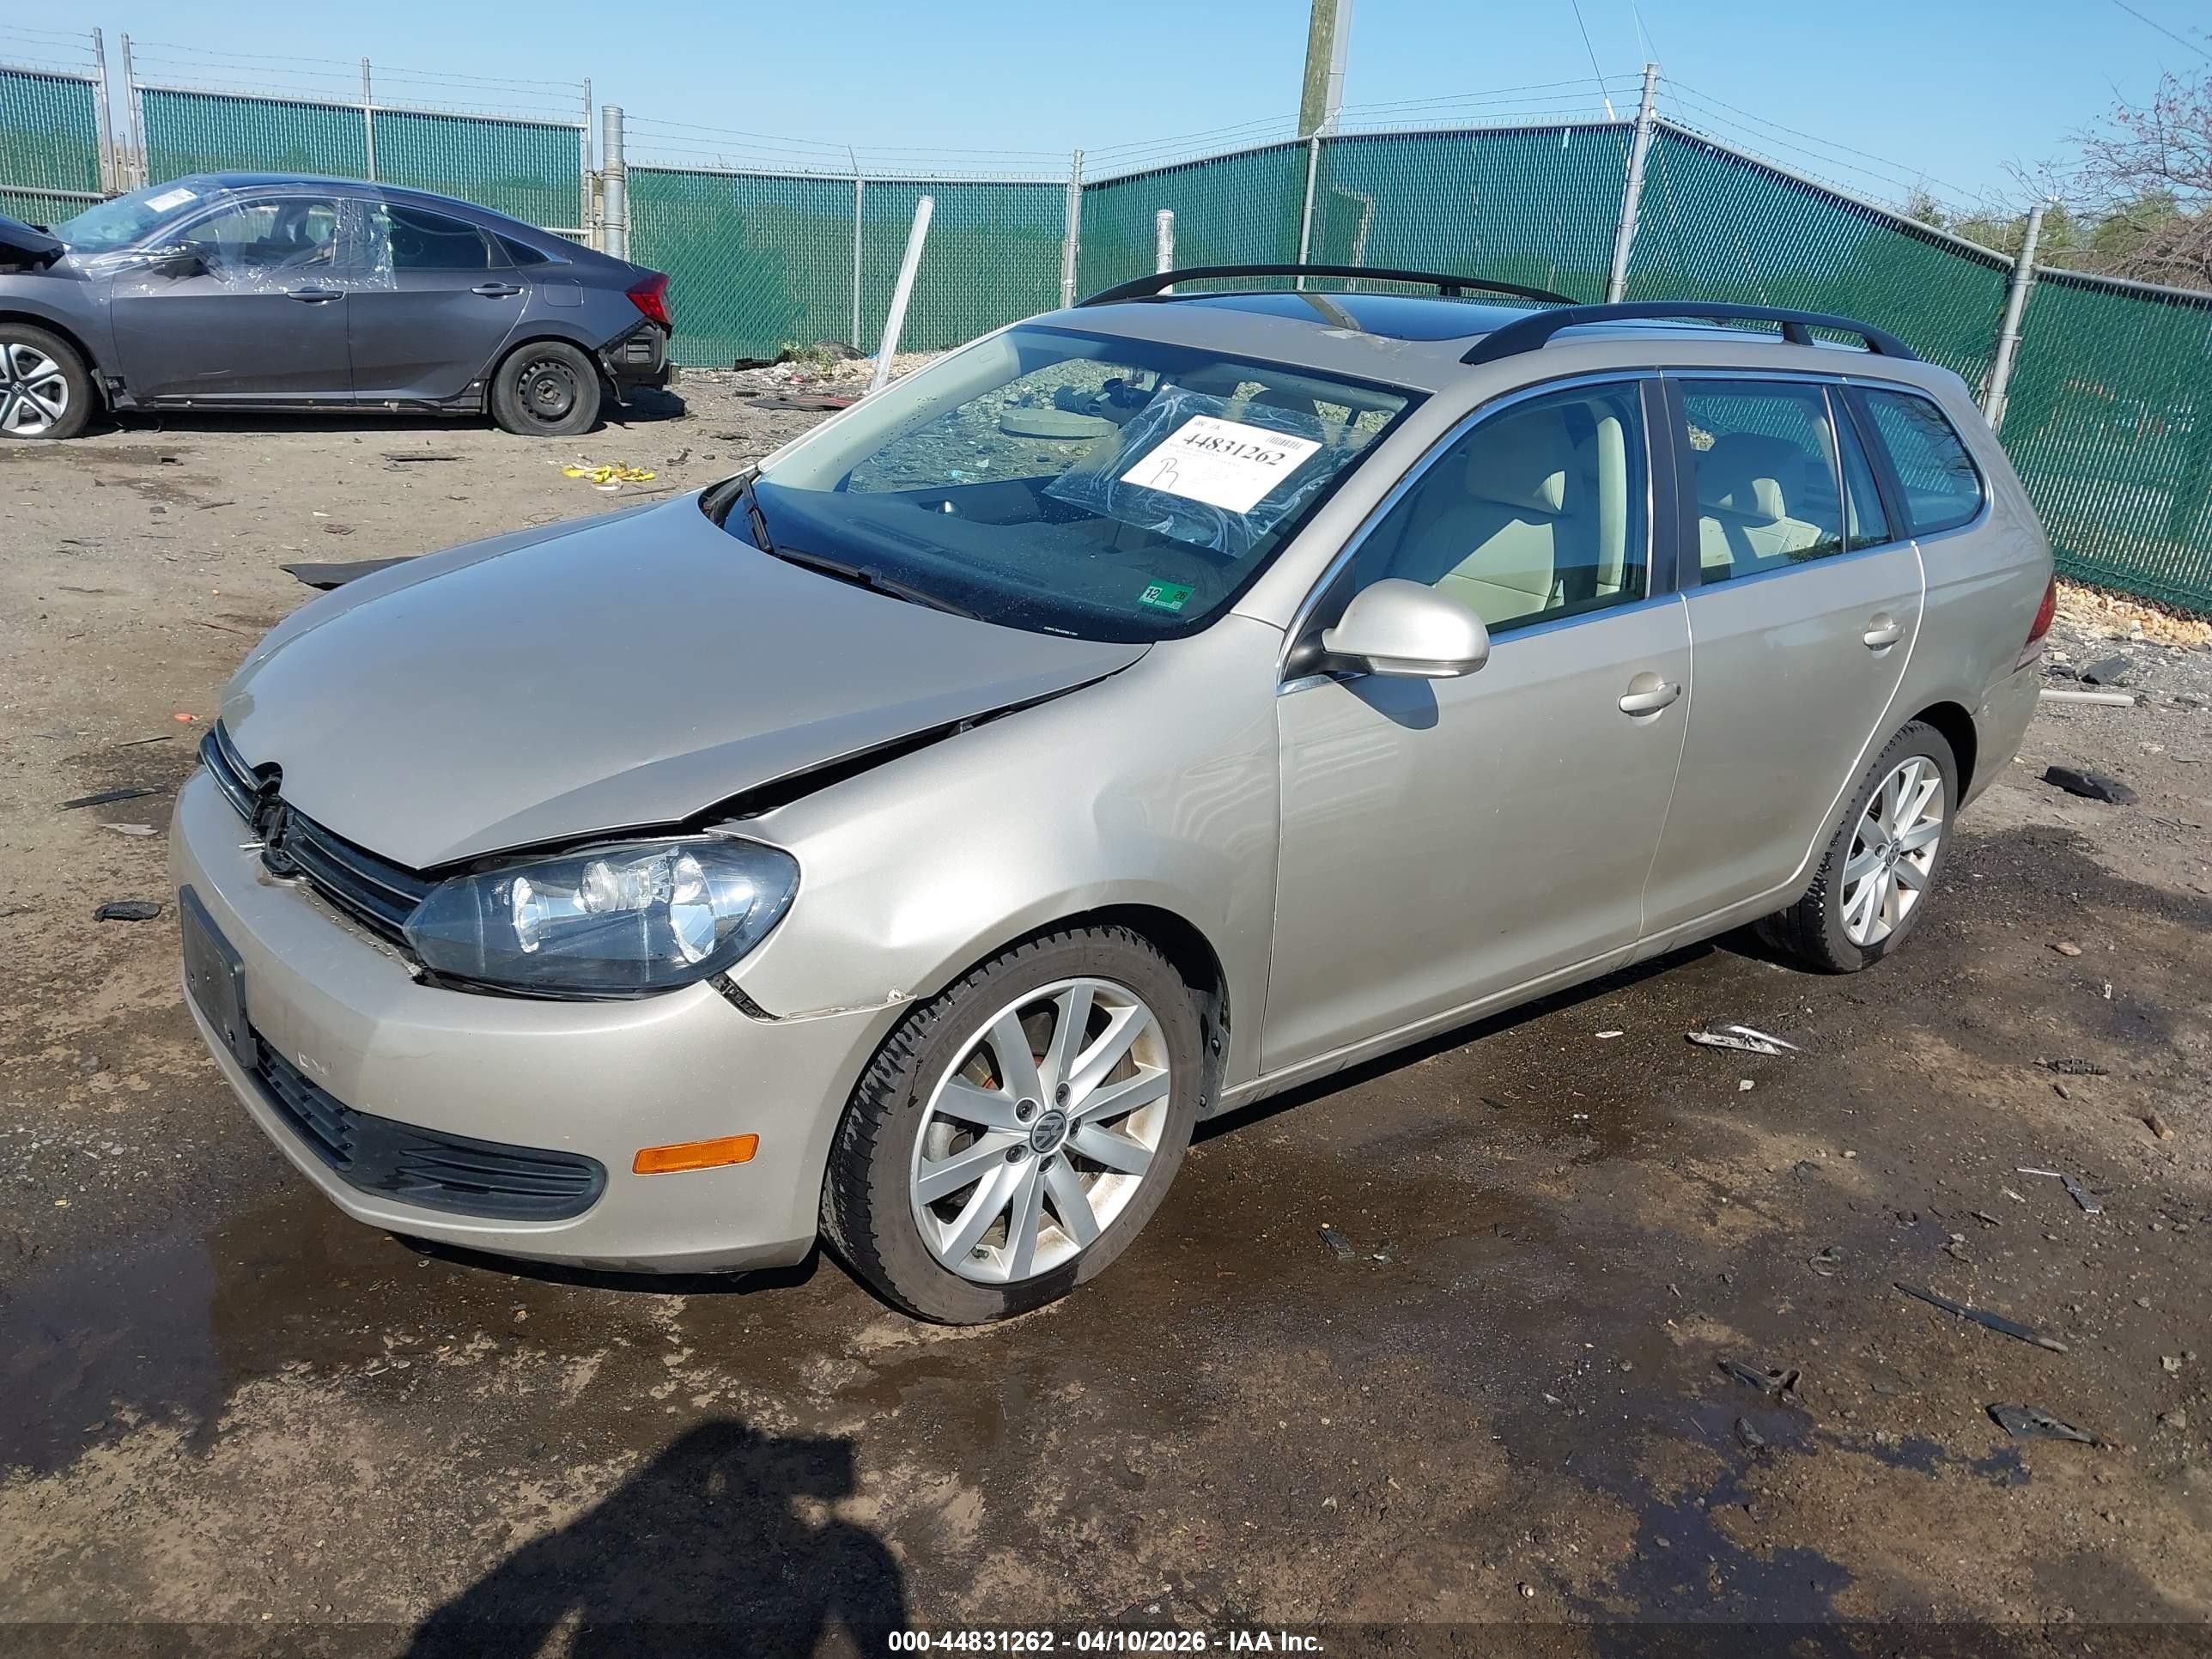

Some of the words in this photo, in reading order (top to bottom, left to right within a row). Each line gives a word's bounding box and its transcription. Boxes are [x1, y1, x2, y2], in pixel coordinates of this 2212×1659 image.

[1182, 433, 1286, 465] 44831262
[1146, 587, 1160, 599] 12
[1173, 590, 1188, 599] 26
